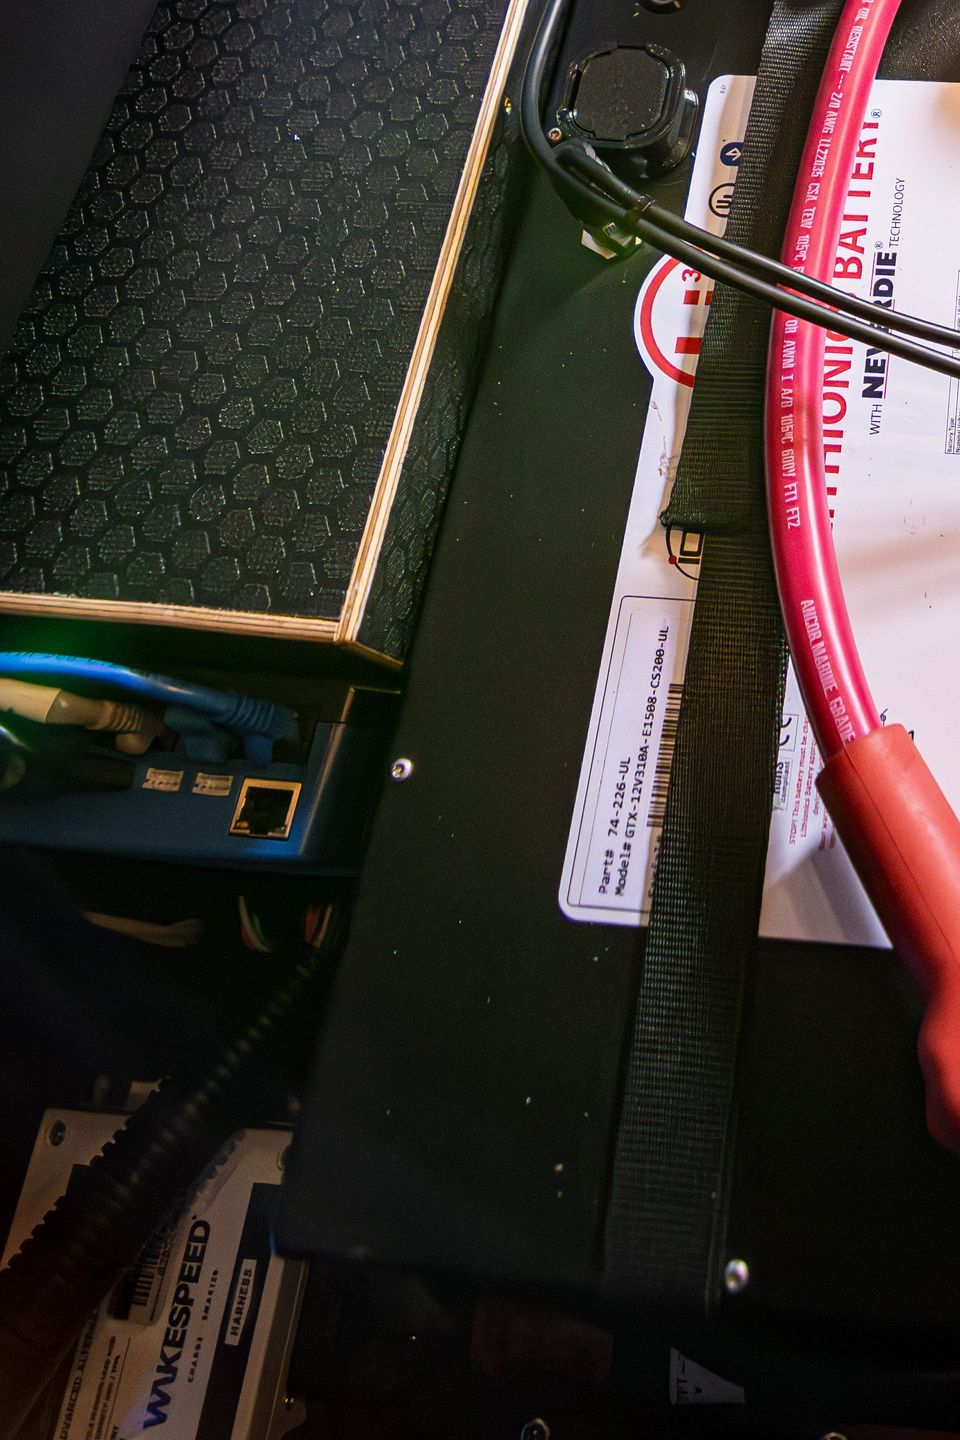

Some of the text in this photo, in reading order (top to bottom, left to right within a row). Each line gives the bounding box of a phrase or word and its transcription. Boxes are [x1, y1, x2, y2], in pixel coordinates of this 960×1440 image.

[839, 25, 864, 73] RESISTANT
[823, 110, 838, 134] AWG
[804, 182, 821, 204] CSA
[869, 404, 882, 435] WITH
[888, 177, 906, 249] TECHNOLOGY
[598, 757, 631, 895] Part# 74-226-UL
[615, 842, 632, 897] Model#
[142, 1219, 211, 1430] WAKESPEED
[230, 1268, 253, 1337] HARNESS
